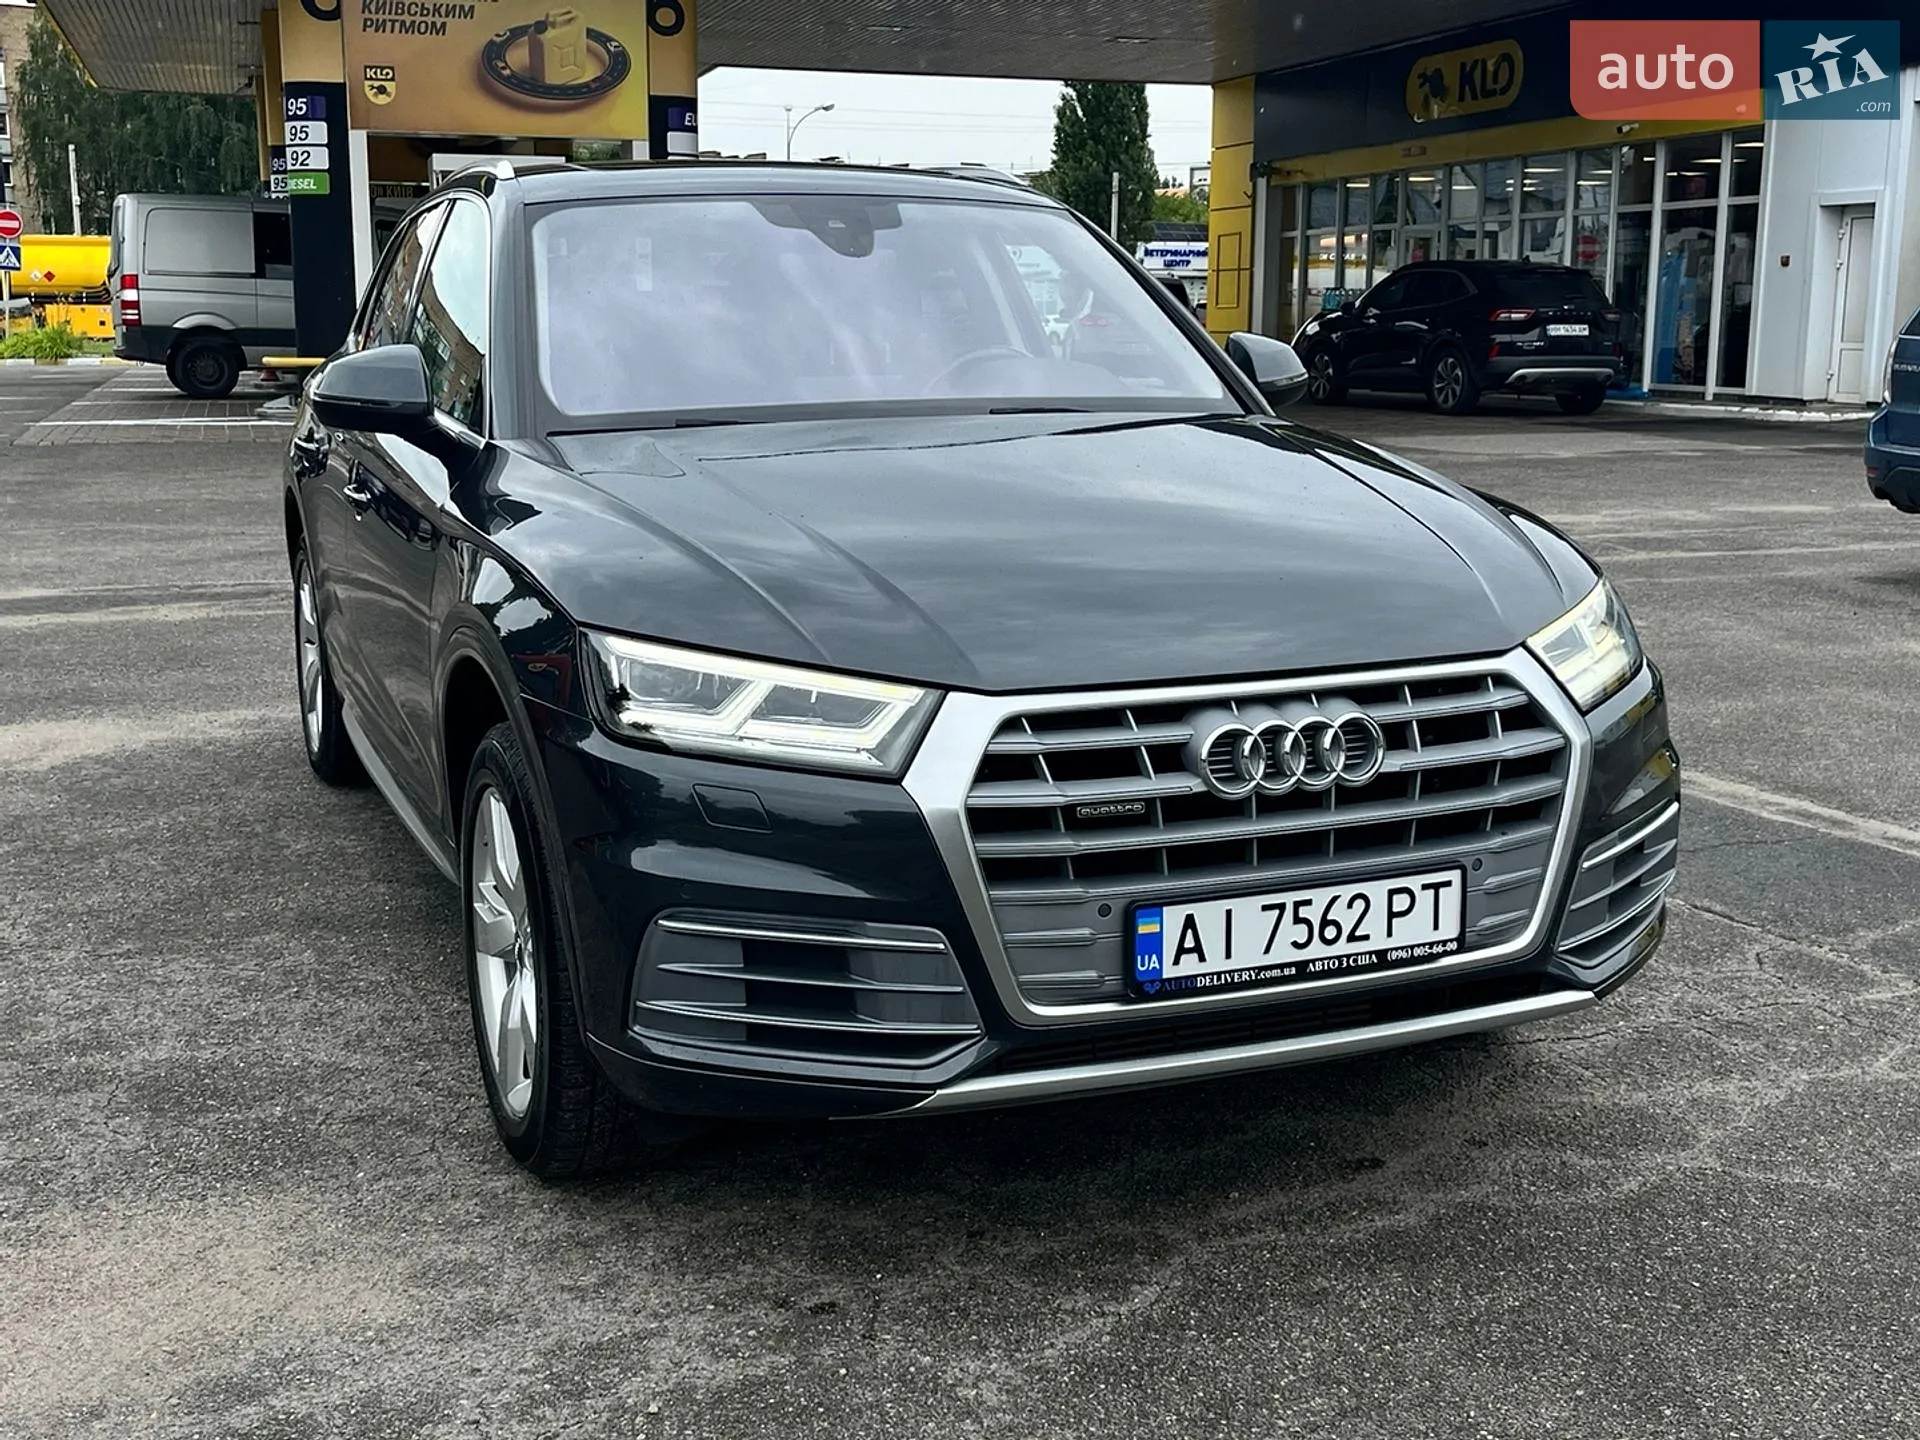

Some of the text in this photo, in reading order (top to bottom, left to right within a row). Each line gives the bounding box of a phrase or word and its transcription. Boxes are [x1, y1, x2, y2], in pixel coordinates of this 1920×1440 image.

[362, 17, 448, 37] РИТМОМ
[366, 66, 393, 79] KLO
[1458, 52, 1515, 102] KLO
[287, 98, 308, 116] 95
[289, 125, 310, 142] 95
[290, 150, 311, 167] 92
[1081, 804, 1142, 816] quattro
[1172, 879, 1453, 966] AI 7562 PT
[1137, 953, 1160, 971] UA
[1306, 959, 1339, 973] АВТО
[1349, 953, 1378, 967] США
[1387, 947, 1412, 963] (096)
